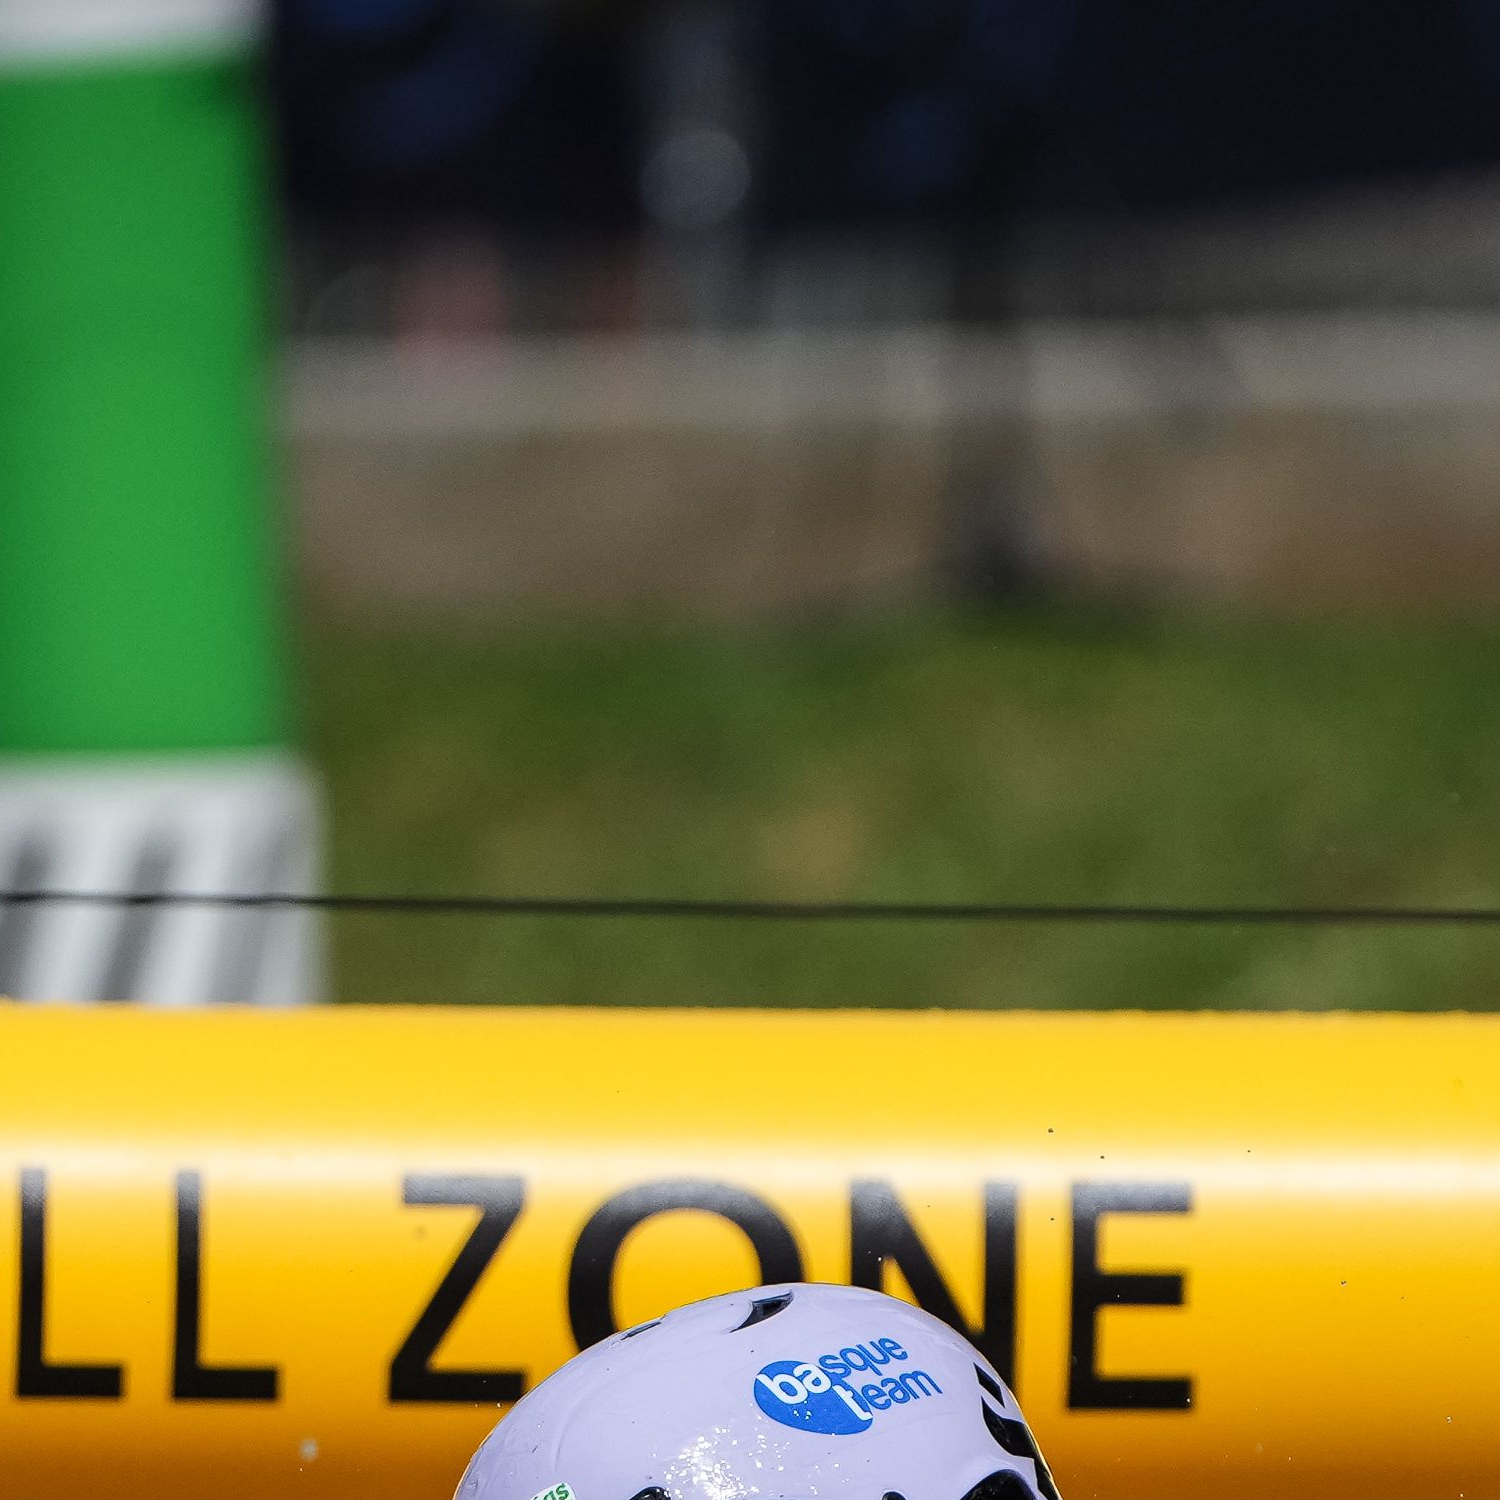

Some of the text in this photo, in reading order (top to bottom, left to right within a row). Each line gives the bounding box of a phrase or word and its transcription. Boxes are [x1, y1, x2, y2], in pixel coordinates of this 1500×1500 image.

[386, 1172, 1193, 1413] ZONE
[756, 1338, 908, 1405] basque
[832, 1371, 943, 1421] team
